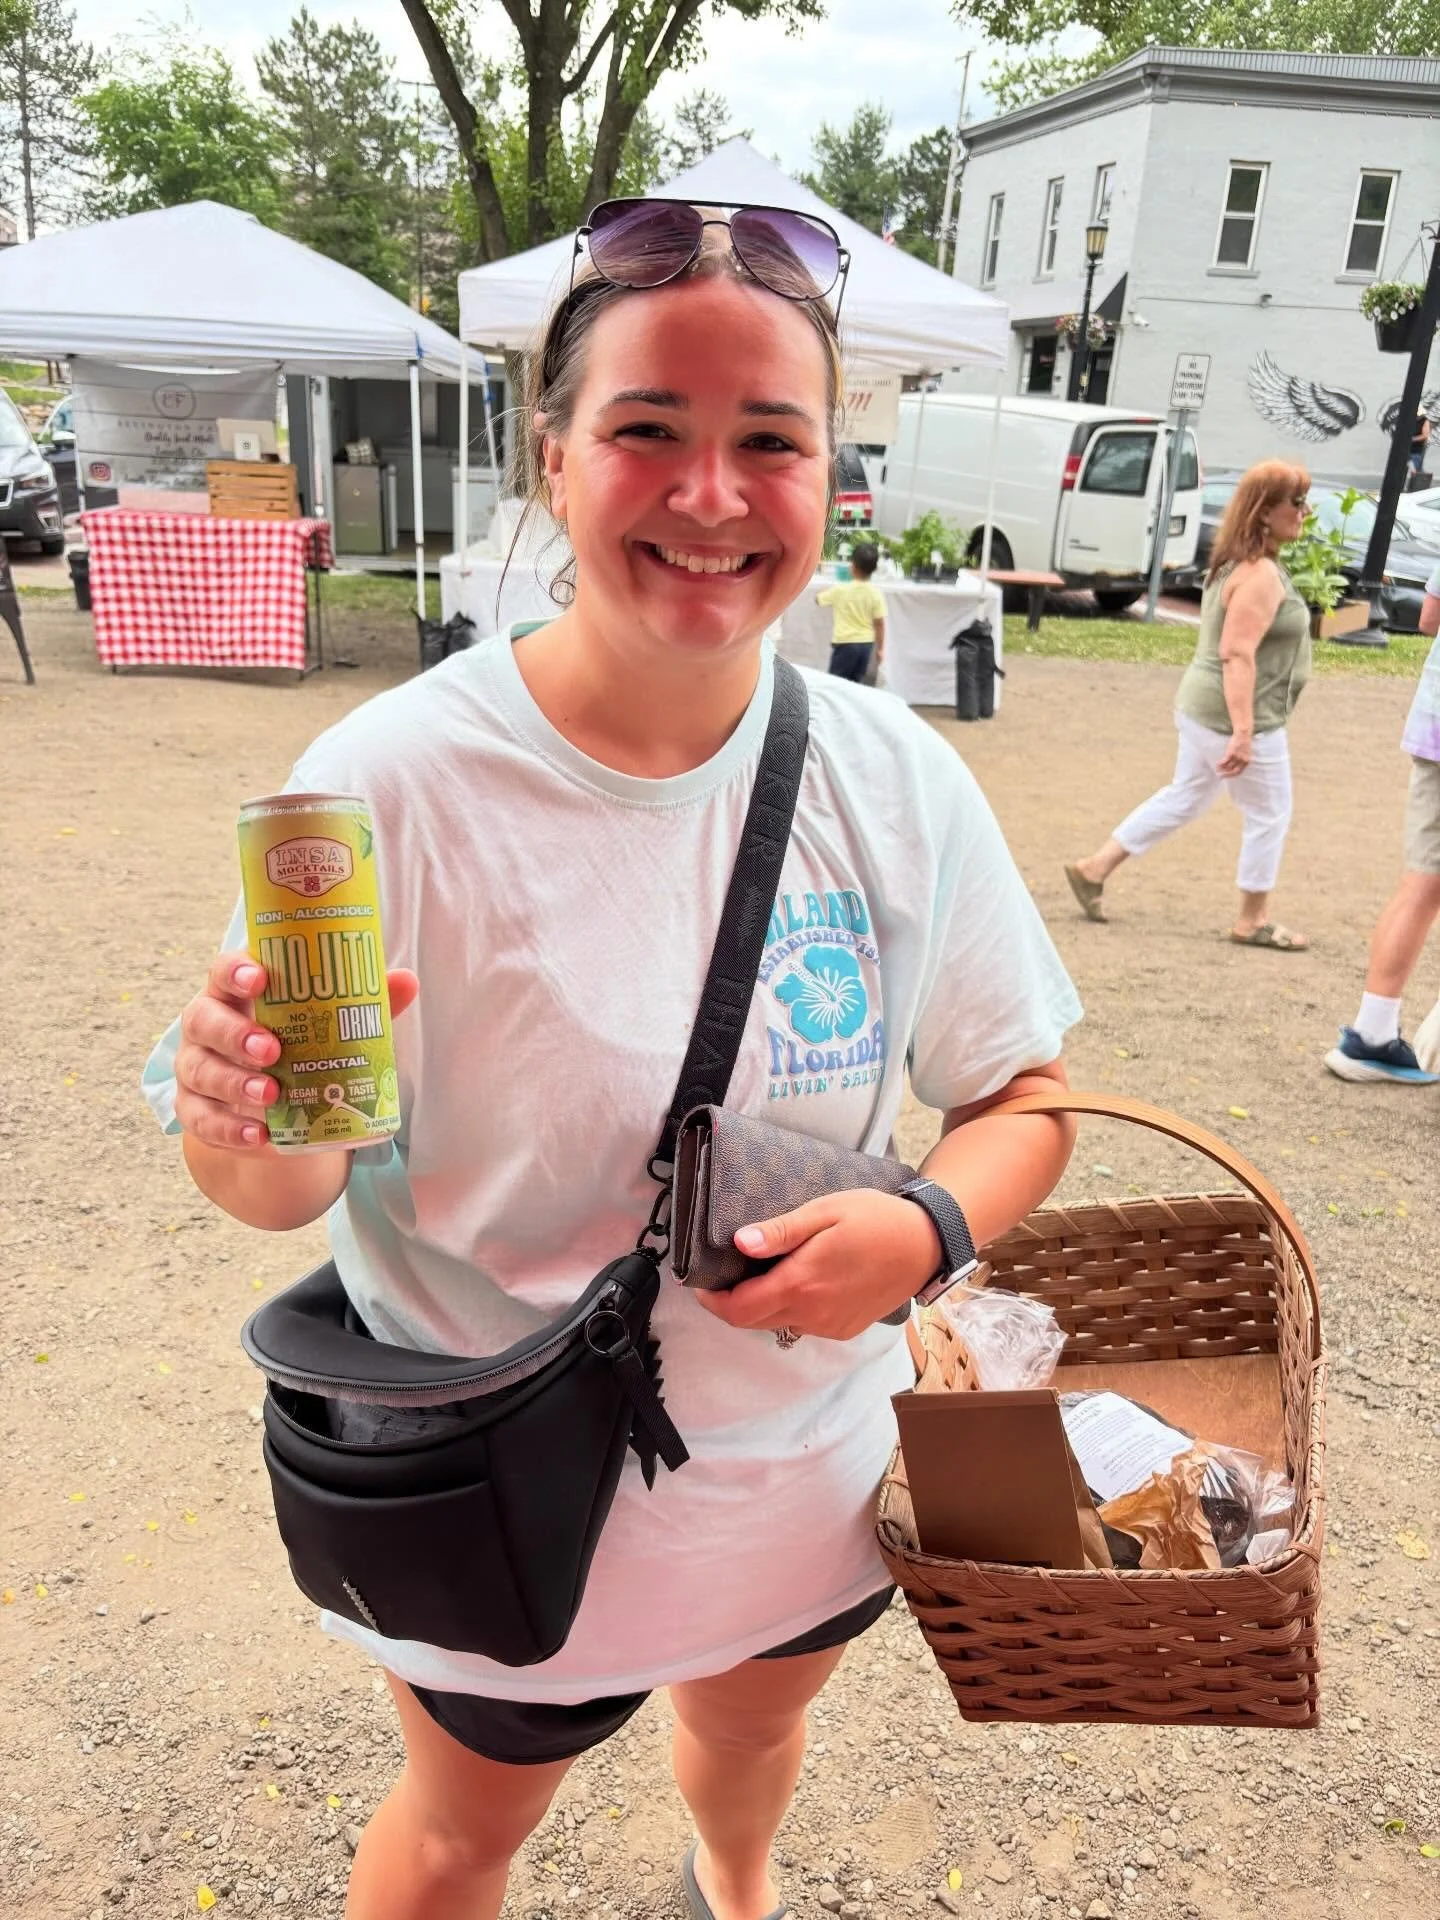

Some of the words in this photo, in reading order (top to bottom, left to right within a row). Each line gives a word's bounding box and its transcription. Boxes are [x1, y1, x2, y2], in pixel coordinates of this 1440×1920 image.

[275, 846, 345, 866] INSA
[277, 864, 345, 877] MOCKTAILS
[256, 911, 282, 925] NON
[293, 905, 374, 921] ALCOHOLIC
[259, 930, 380, 1005] MOJITO
[289, 1012, 308, 1022] NO
[337, 1002, 384, 1042] DRINK
[272, 1024, 309, 1035] ADDED
[280, 1035, 310, 1046] UGAR
[291, 1056, 369, 1073] MOCKTAIL
[288, 1087, 318, 1099] VEGAN
[348, 1083, 376, 1097] TASTE
